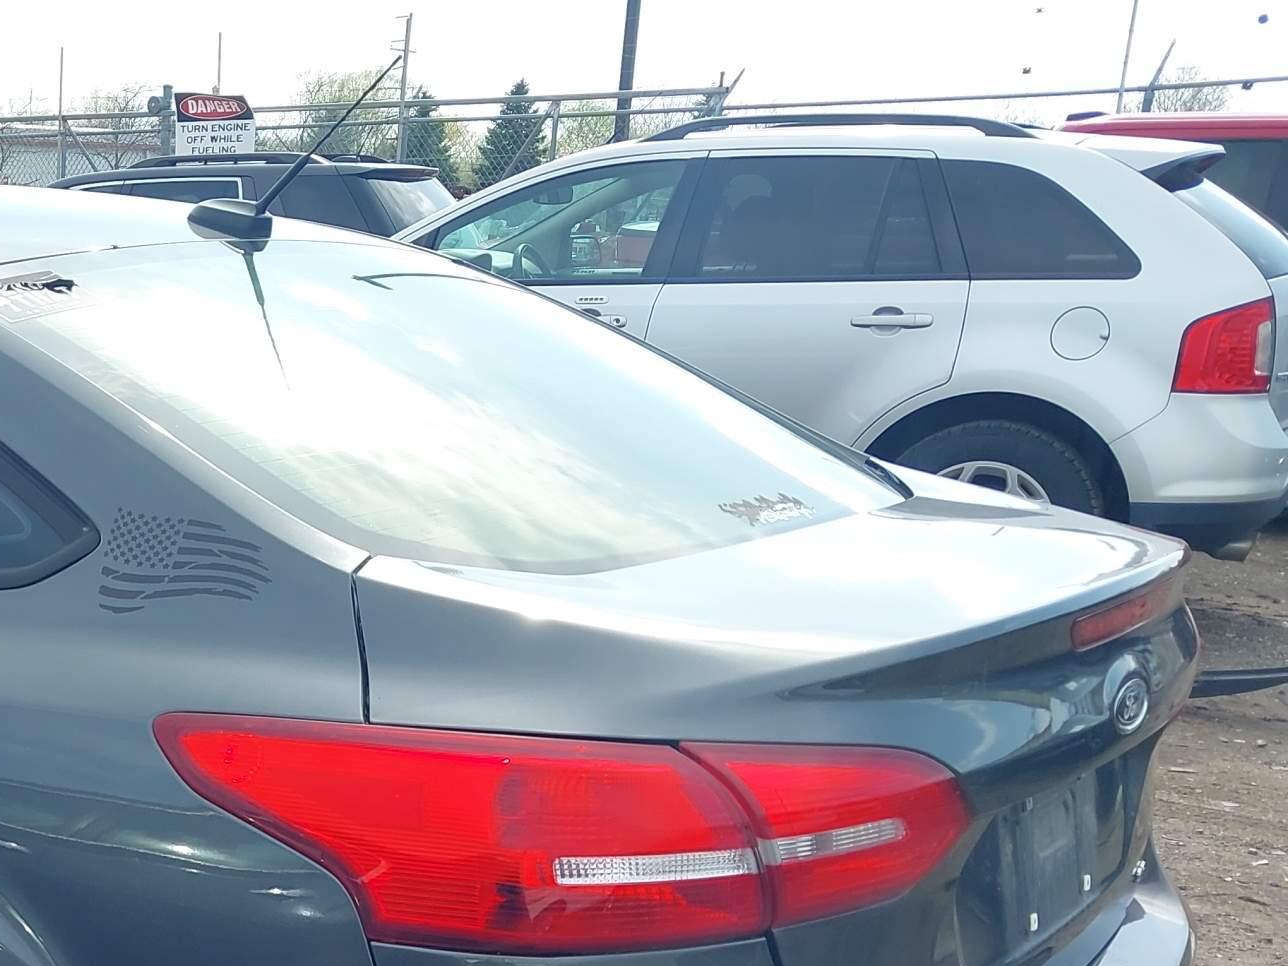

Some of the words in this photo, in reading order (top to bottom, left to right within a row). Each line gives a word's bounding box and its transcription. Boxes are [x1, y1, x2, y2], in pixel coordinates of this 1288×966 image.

[187, 99, 241, 114] DANGER
[180, 124, 209, 133] TURN
[211, 122, 251, 132] ENGINE
[186, 135, 207, 144] OFF
[210, 134, 244, 143] WHILE
[191, 145, 237, 155] FUELING
